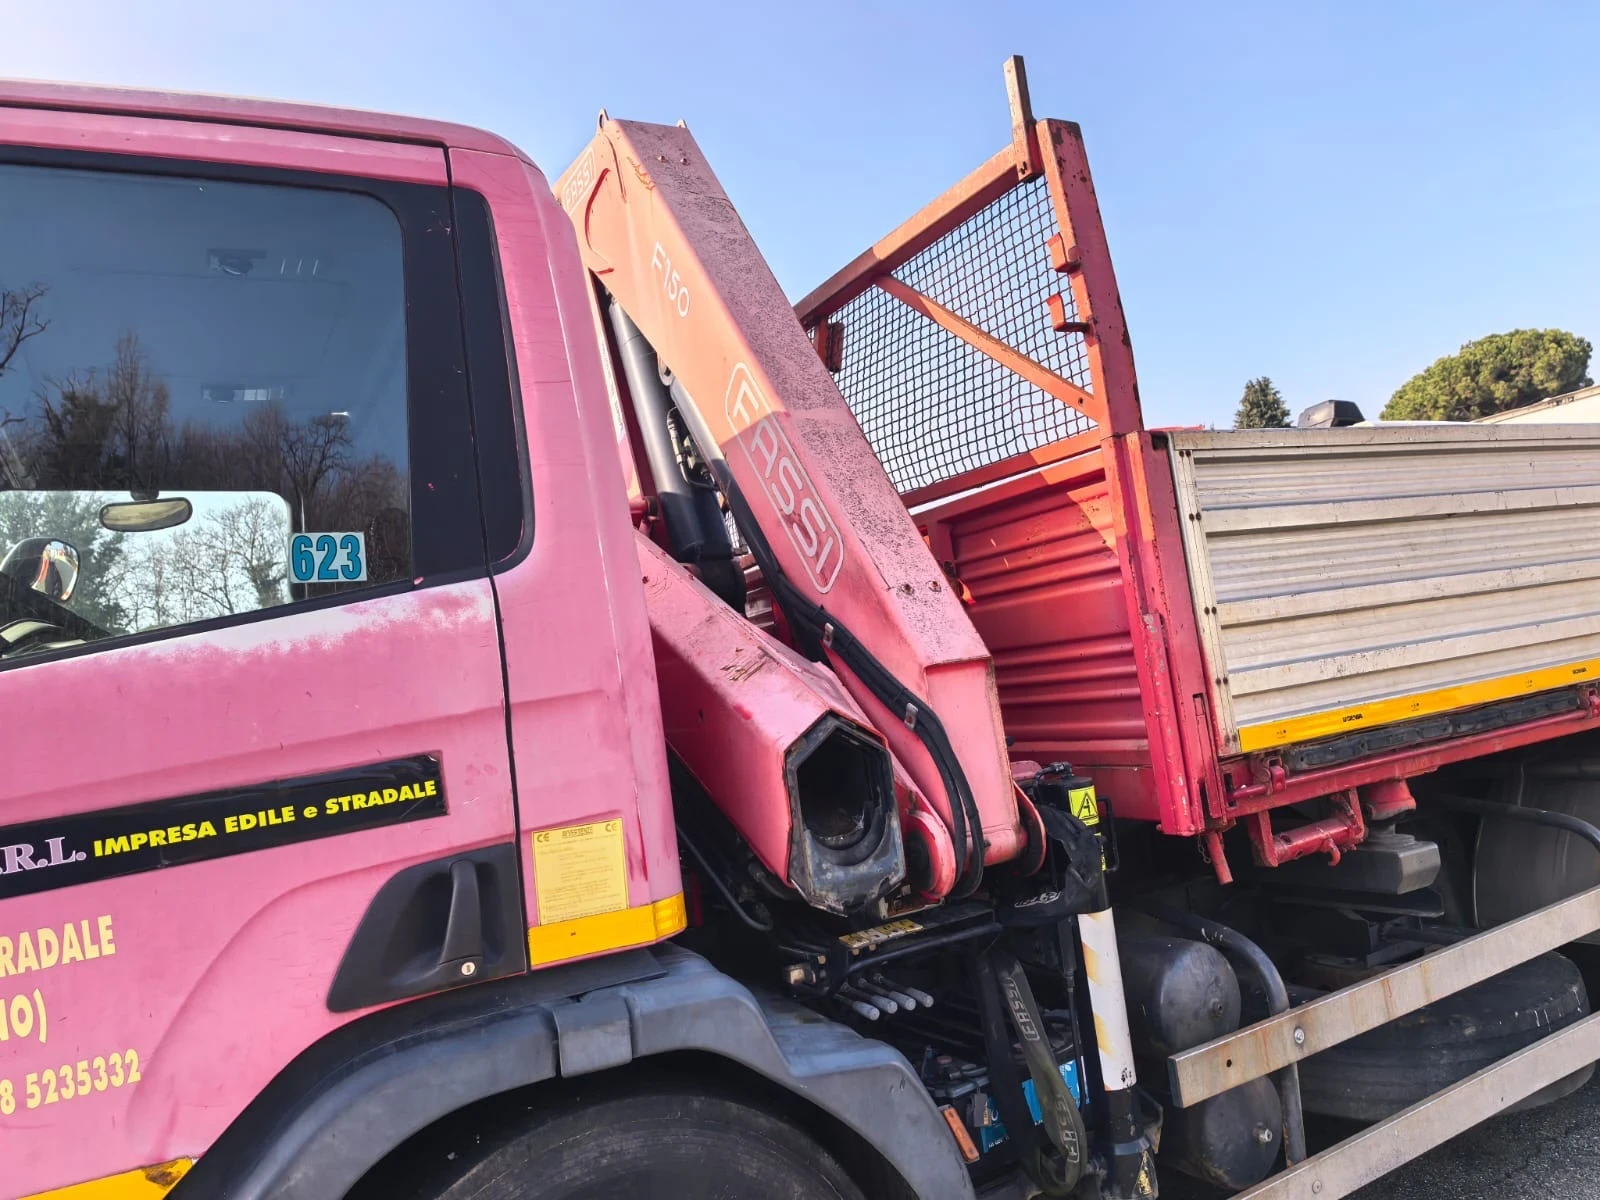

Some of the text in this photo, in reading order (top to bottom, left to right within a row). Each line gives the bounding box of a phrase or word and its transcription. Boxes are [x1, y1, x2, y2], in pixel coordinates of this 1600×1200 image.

[651, 240, 690, 318] F150
[732, 378, 834, 574] FASSI
[291, 534, 362, 581] 623
[93, 821, 218, 857] IMPRESA
[224, 806, 296, 834] EDILE
[303, 806, 318, 819] e
[325, 780, 438, 815] STRADALE
[0, 914, 116, 978] RADALE
[25, 1048, 141, 1109] 5235332
